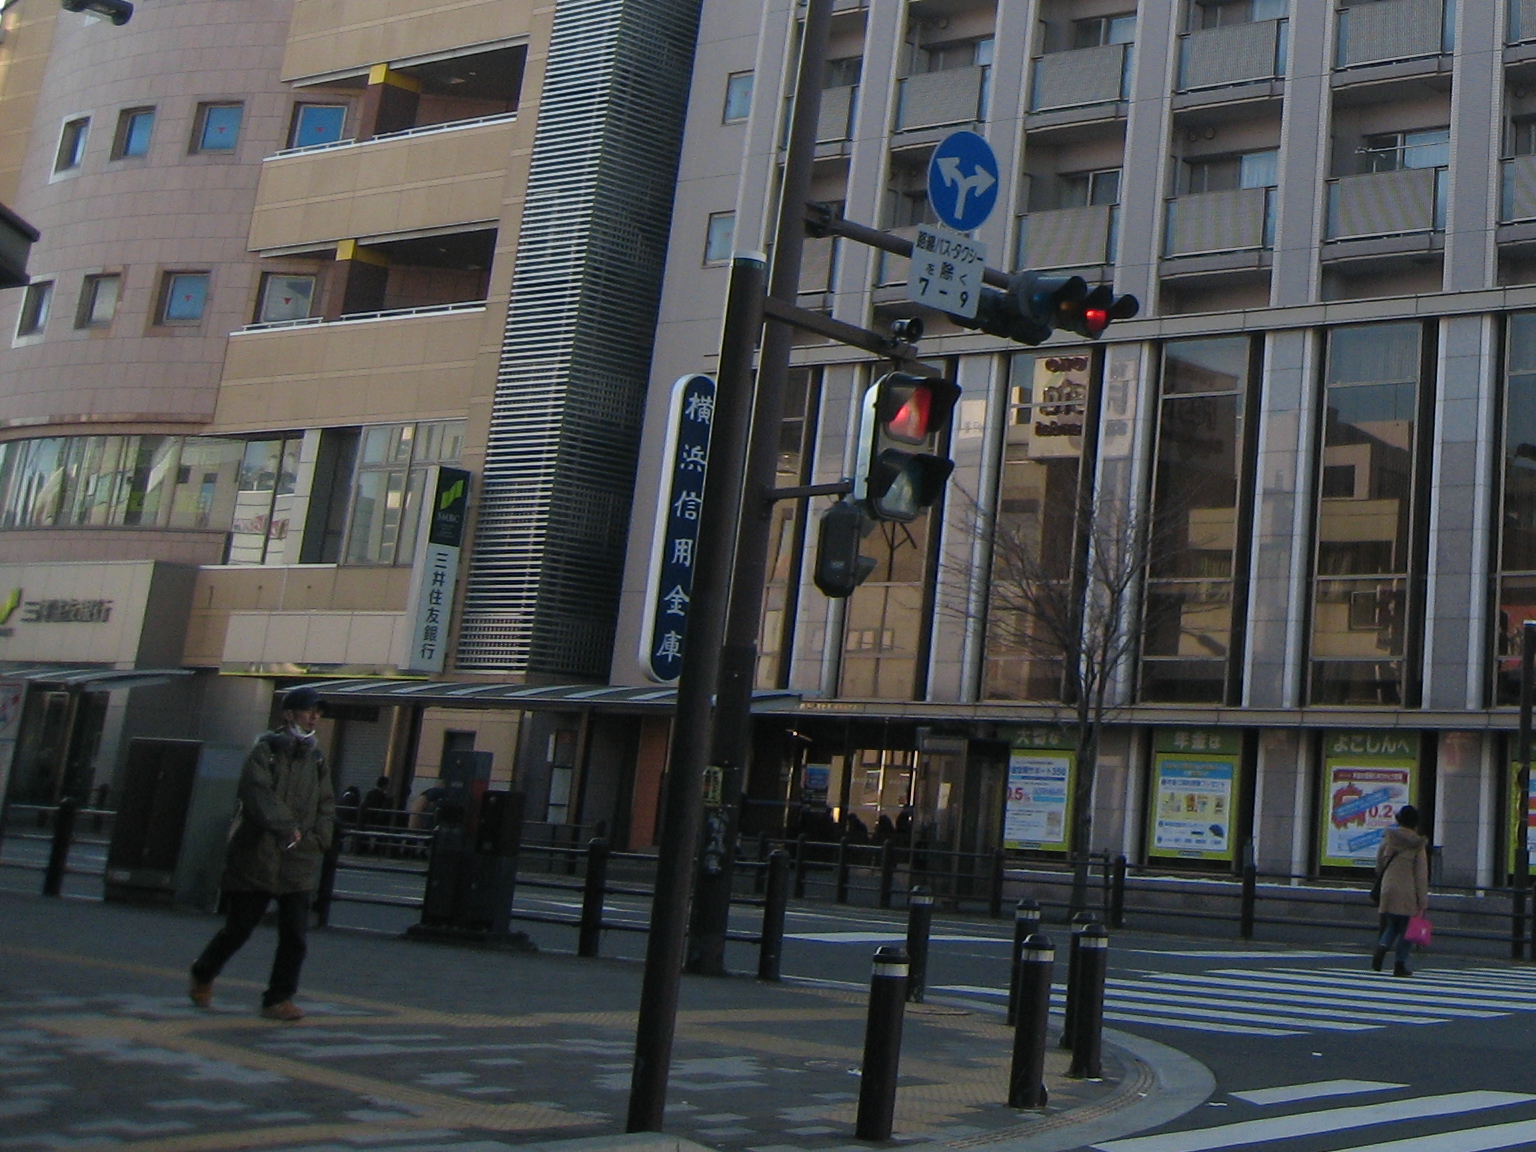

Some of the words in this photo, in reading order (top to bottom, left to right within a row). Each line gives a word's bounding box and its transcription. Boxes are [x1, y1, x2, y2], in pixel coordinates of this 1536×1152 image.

[656, 392, 714, 663] 横浜信用金庫
[420, 552, 449, 660] 三井住友銀行
[1333, 734, 1409, 754] よこしんへ
